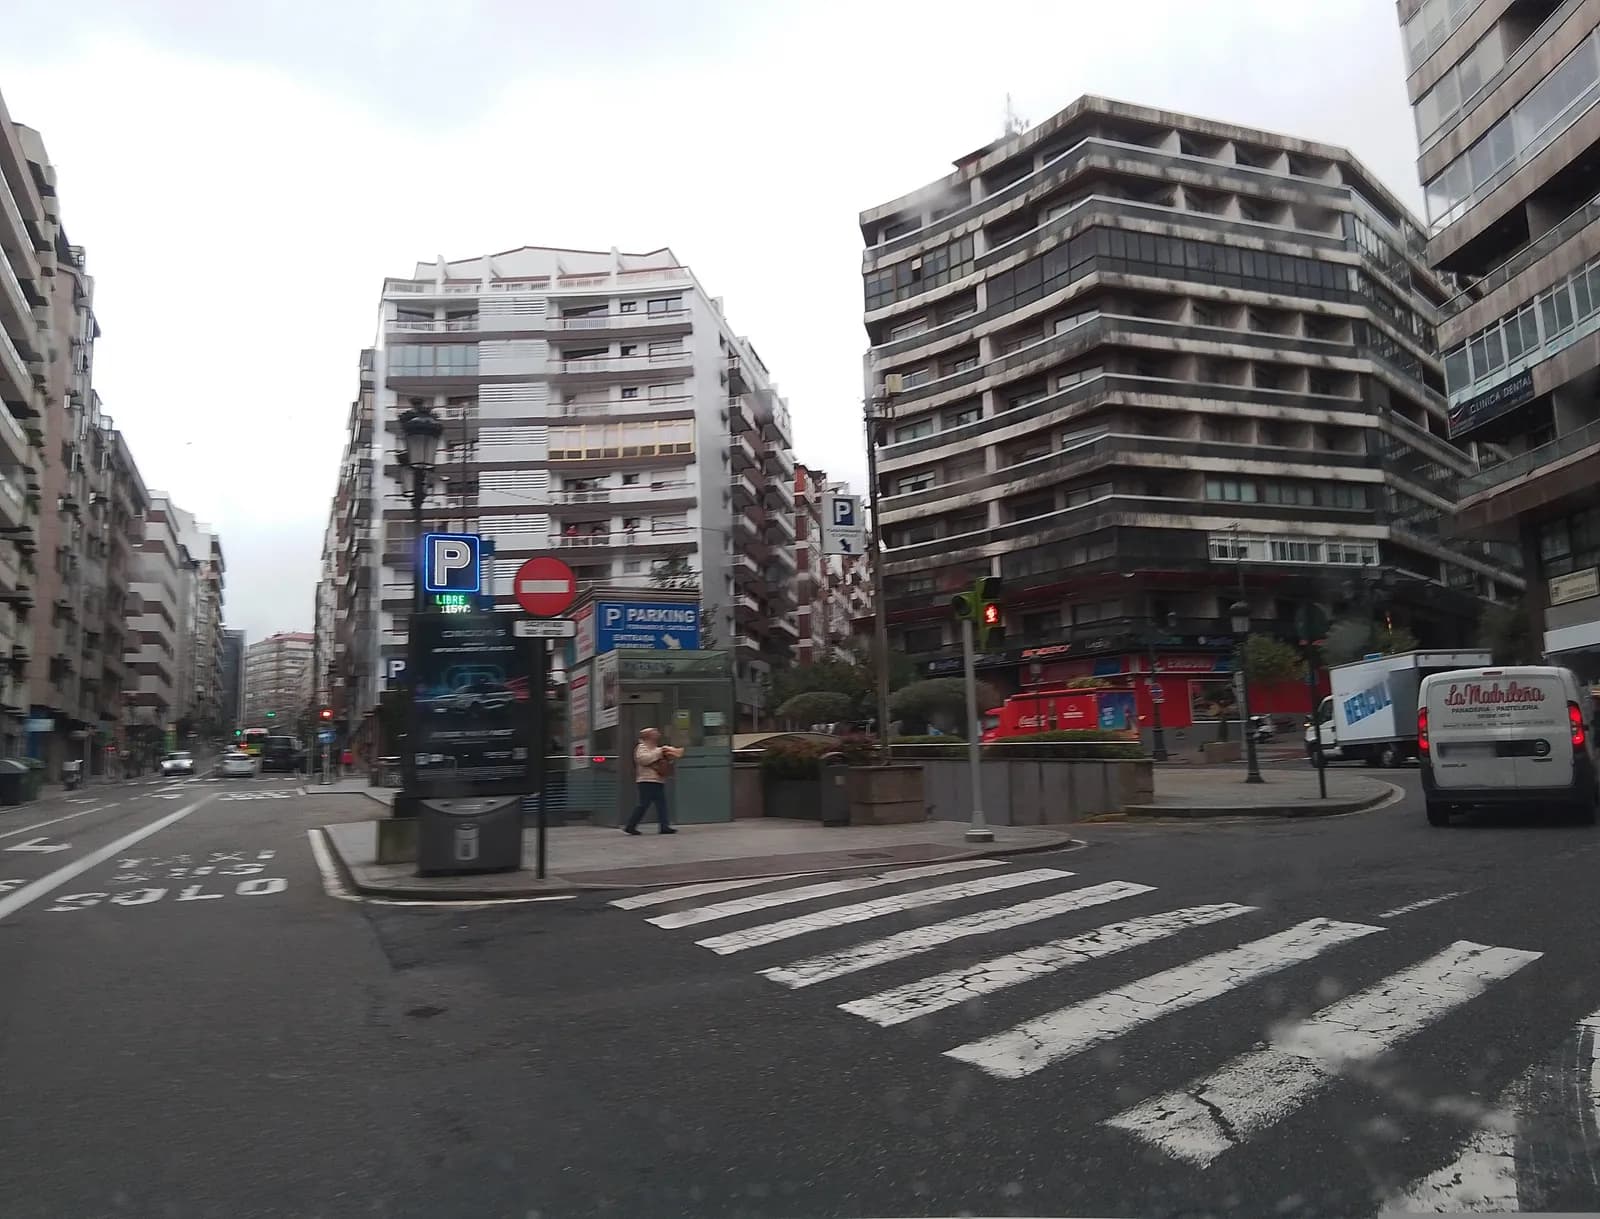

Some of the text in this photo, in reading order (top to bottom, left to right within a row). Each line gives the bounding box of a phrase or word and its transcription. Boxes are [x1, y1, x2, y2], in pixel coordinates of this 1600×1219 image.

[1470, 391, 1501, 414] CLINICA
[1503, 375, 1532, 398] DENTAL
[834, 501, 852, 523] P
[434, 540, 471, 586] P
[435, 594, 465, 605] LIBRE
[606, 608, 621, 627] P
[626, 608, 696, 623] PARKING
[389, 660, 406, 678] P
[1444, 684, 1467, 706] La
[44, 877, 288, 912] SOLO
